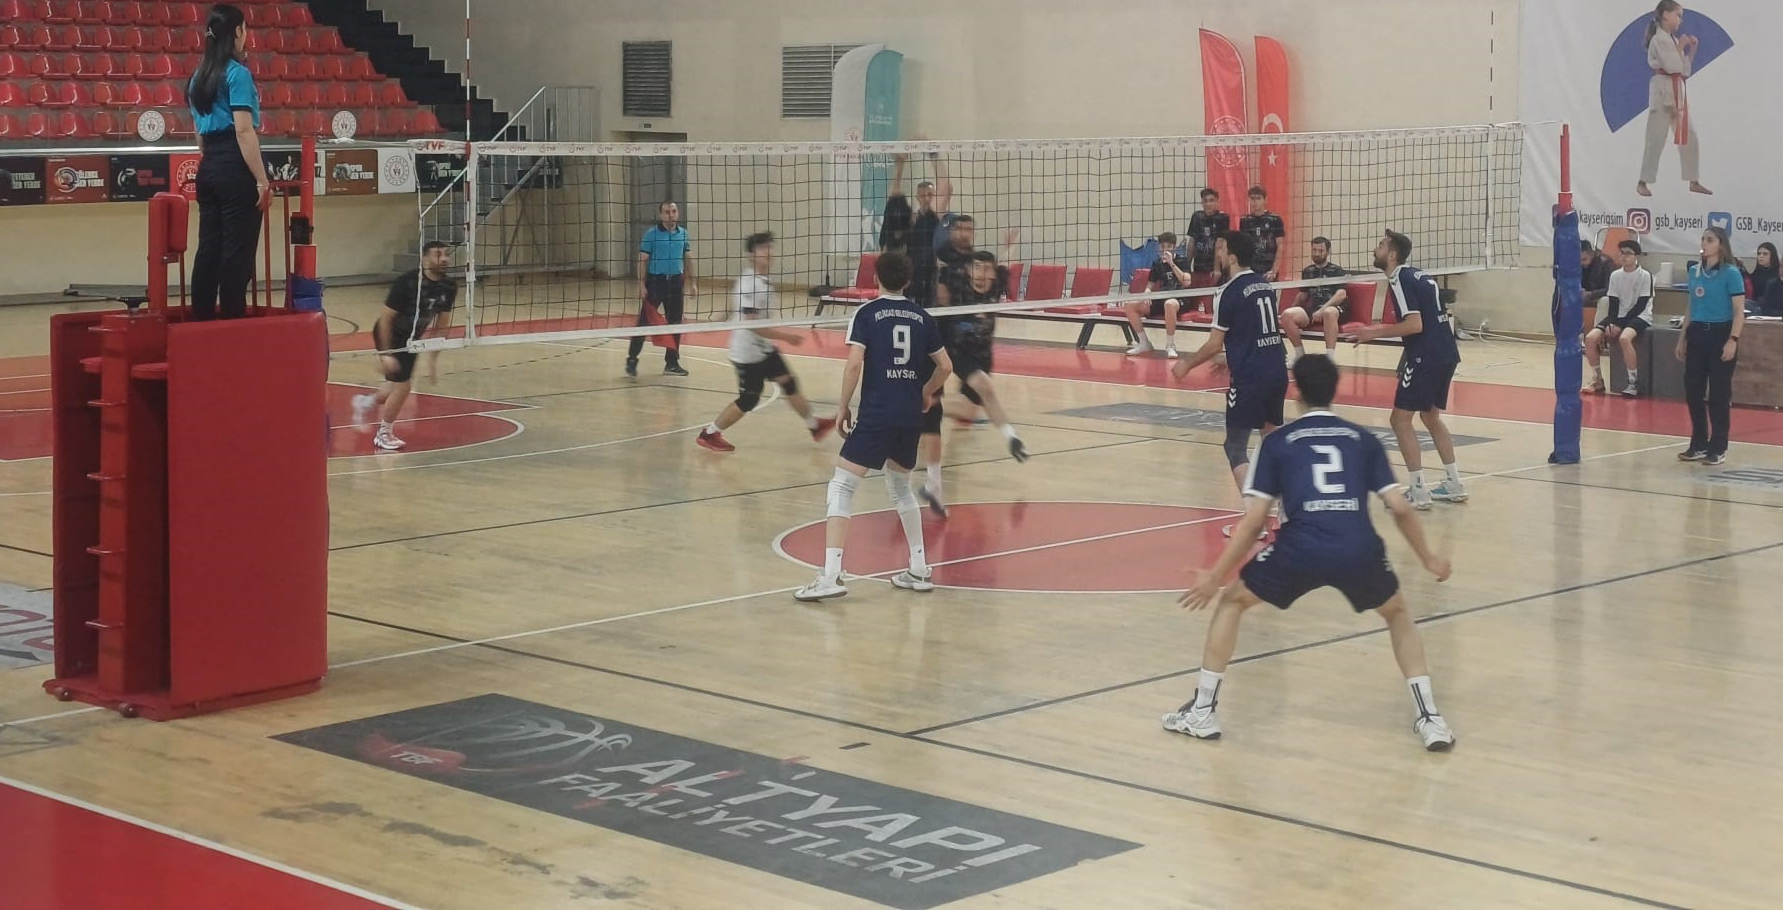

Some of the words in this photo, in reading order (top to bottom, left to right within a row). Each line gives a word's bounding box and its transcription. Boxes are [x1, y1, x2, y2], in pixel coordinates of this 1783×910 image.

[424, 140, 445, 150] TVF
[1655, 212, 1703, 231] gsb_kayseri
[1257, 296, 1277, 334] 11
[892, 324, 911, 365] 9
[886, 369, 918, 380] KAYSR
[1309, 445, 1345, 494] 2
[538, 773, 968, 884] FAALİYETLERİ
[596, 758, 1043, 868] ALTYAPI
